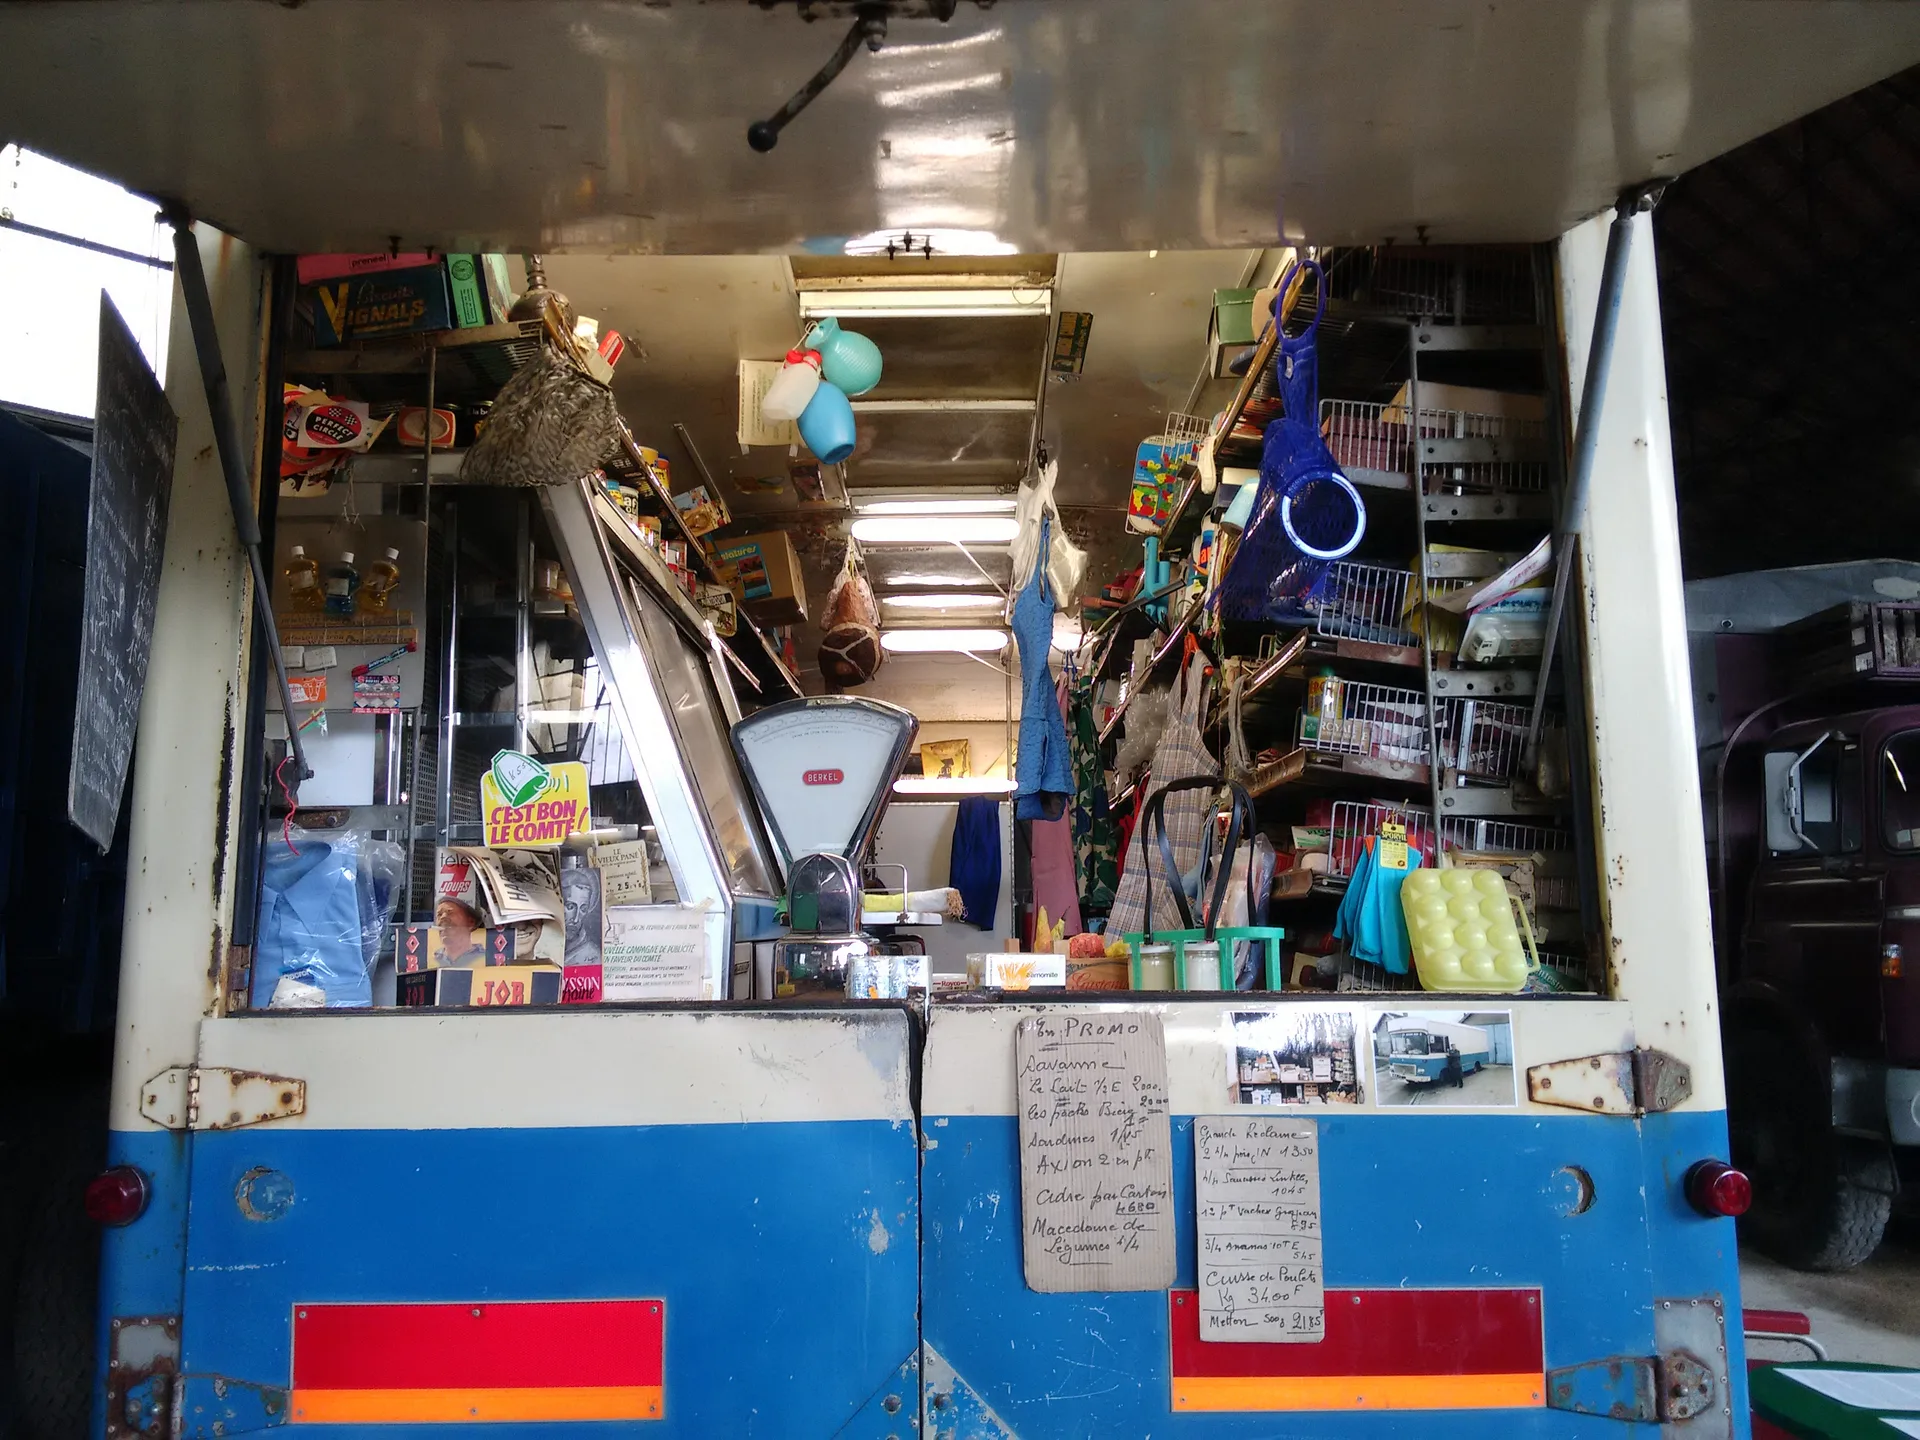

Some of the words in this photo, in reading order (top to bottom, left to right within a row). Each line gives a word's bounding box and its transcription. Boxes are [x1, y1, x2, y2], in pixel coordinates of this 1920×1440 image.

[313, 424, 344, 441] CIRCLE
[315, 416, 354, 436] PERFECT
[807, 772, 839, 783] BERKEL
[537, 799, 577, 821] BON
[490, 825, 511, 845] LE
[597, 854, 620, 864] VIEUX
[439, 880, 471, 894] JOURS
[476, 979, 525, 1006] JOB
